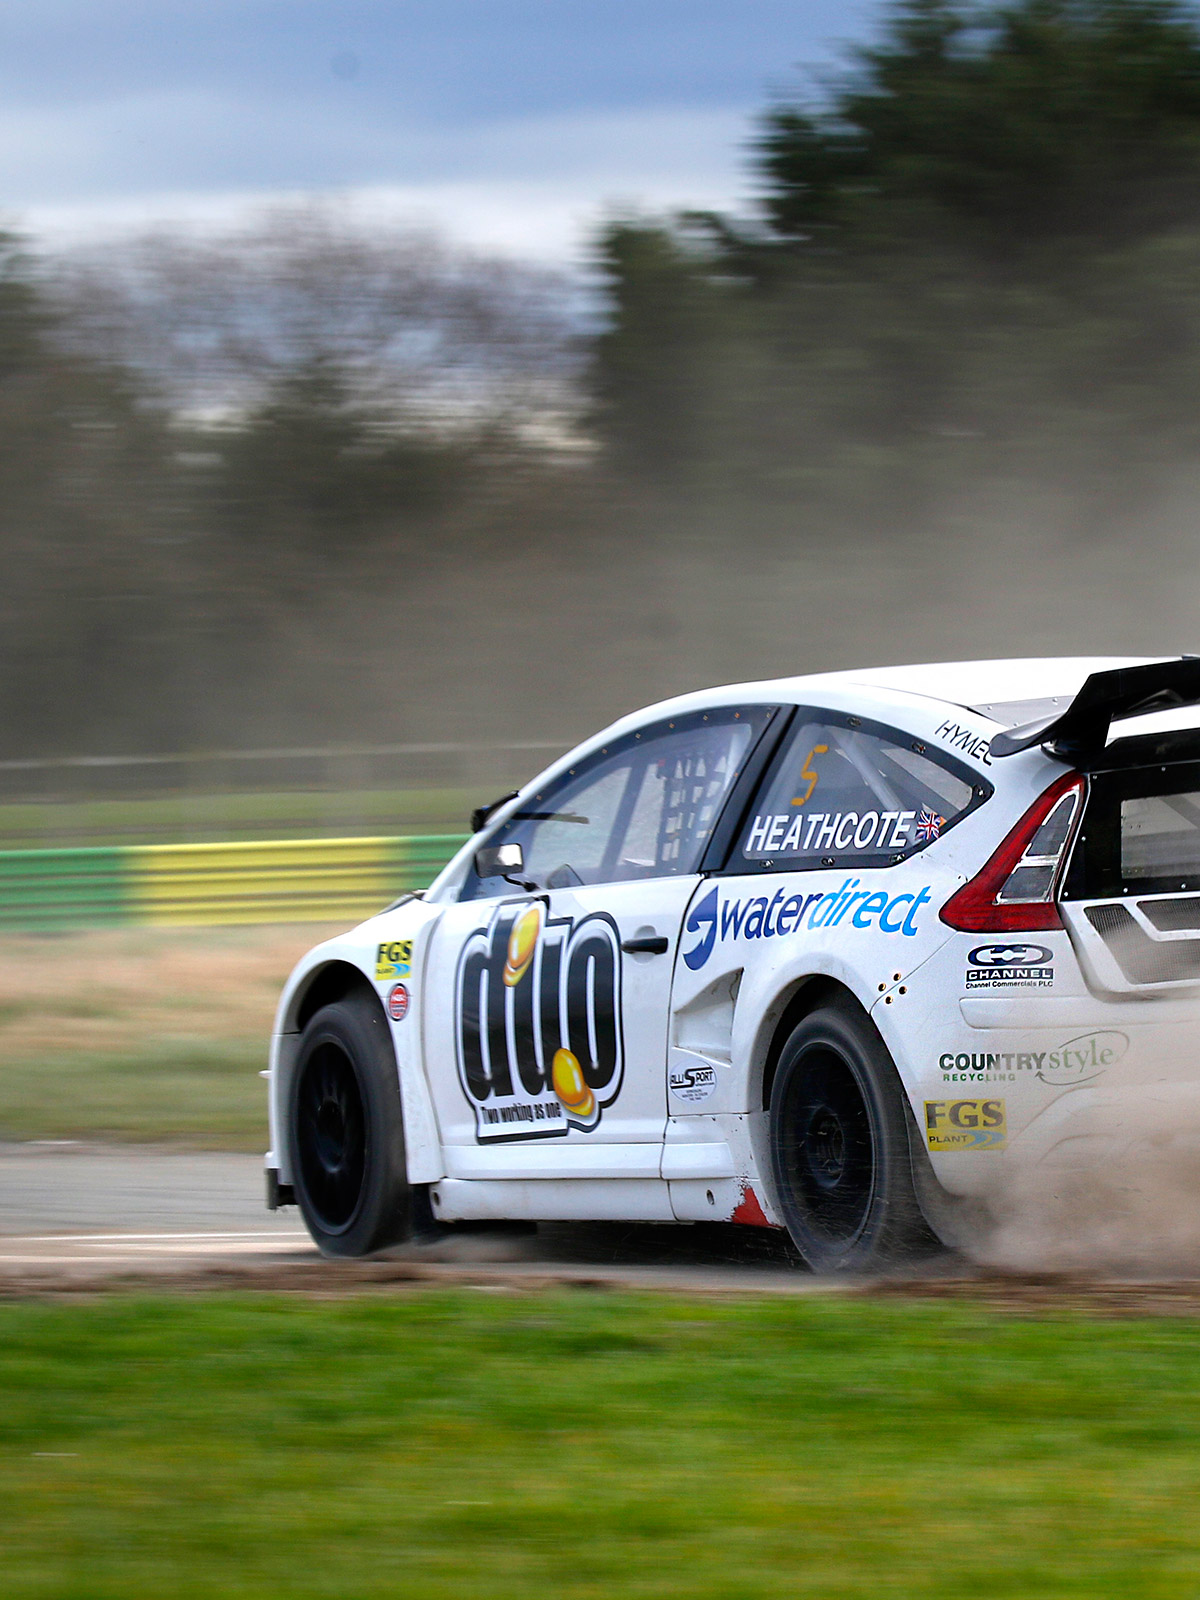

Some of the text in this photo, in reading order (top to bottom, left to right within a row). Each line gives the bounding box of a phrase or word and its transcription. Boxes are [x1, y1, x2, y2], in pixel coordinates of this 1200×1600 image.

[791, 745, 828, 806] 5
[746, 811, 916, 851] HEATHCOTE
[721, 878, 931, 942] waterdirect
[376, 941, 413, 963] FGS
[966, 981, 991, 989] Channel
[992, 980, 1036, 988] Commercials
[968, 969, 1051, 980] CHANNEL
[461, 908, 620, 1102] duo
[943, 1073, 1016, 1082] RECYCLING
[926, 1100, 1004, 1129] FGS
[929, 1135, 968, 1143] PLANT
